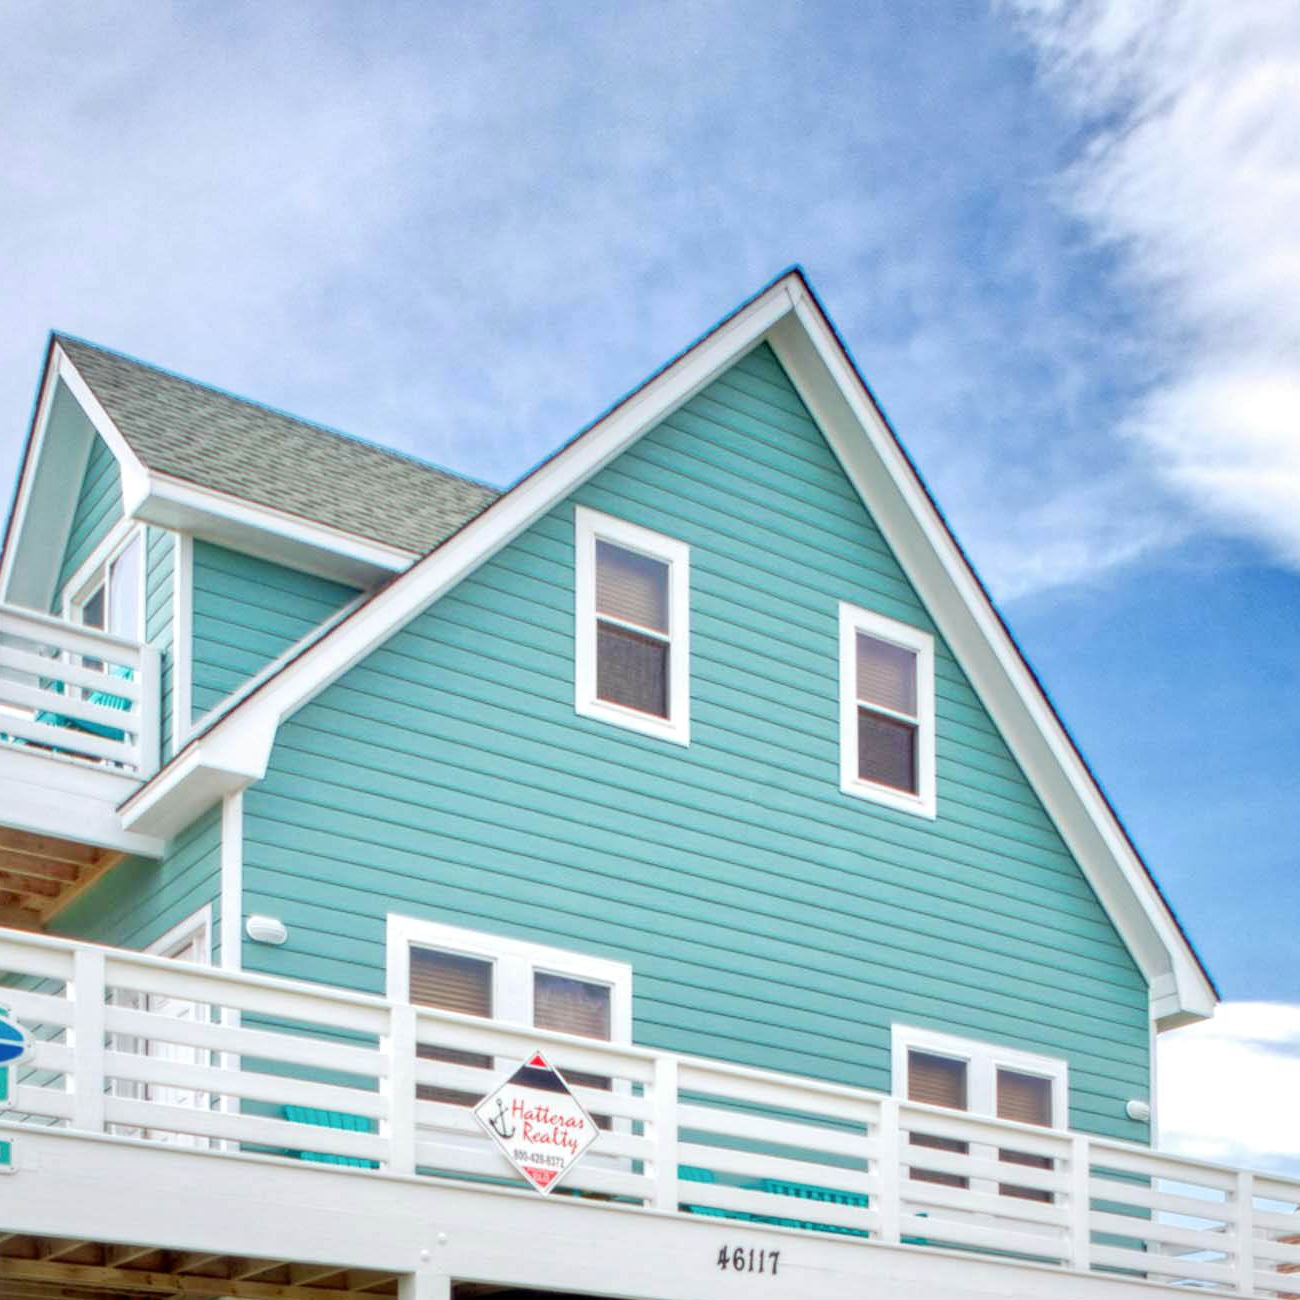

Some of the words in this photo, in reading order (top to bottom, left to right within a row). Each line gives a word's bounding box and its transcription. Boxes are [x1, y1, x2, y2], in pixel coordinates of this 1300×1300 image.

[512, 1099, 584, 1129] Hatteras
[523, 1121, 578, 1154] Realty
[717, 1245, 780, 1275] 46117
